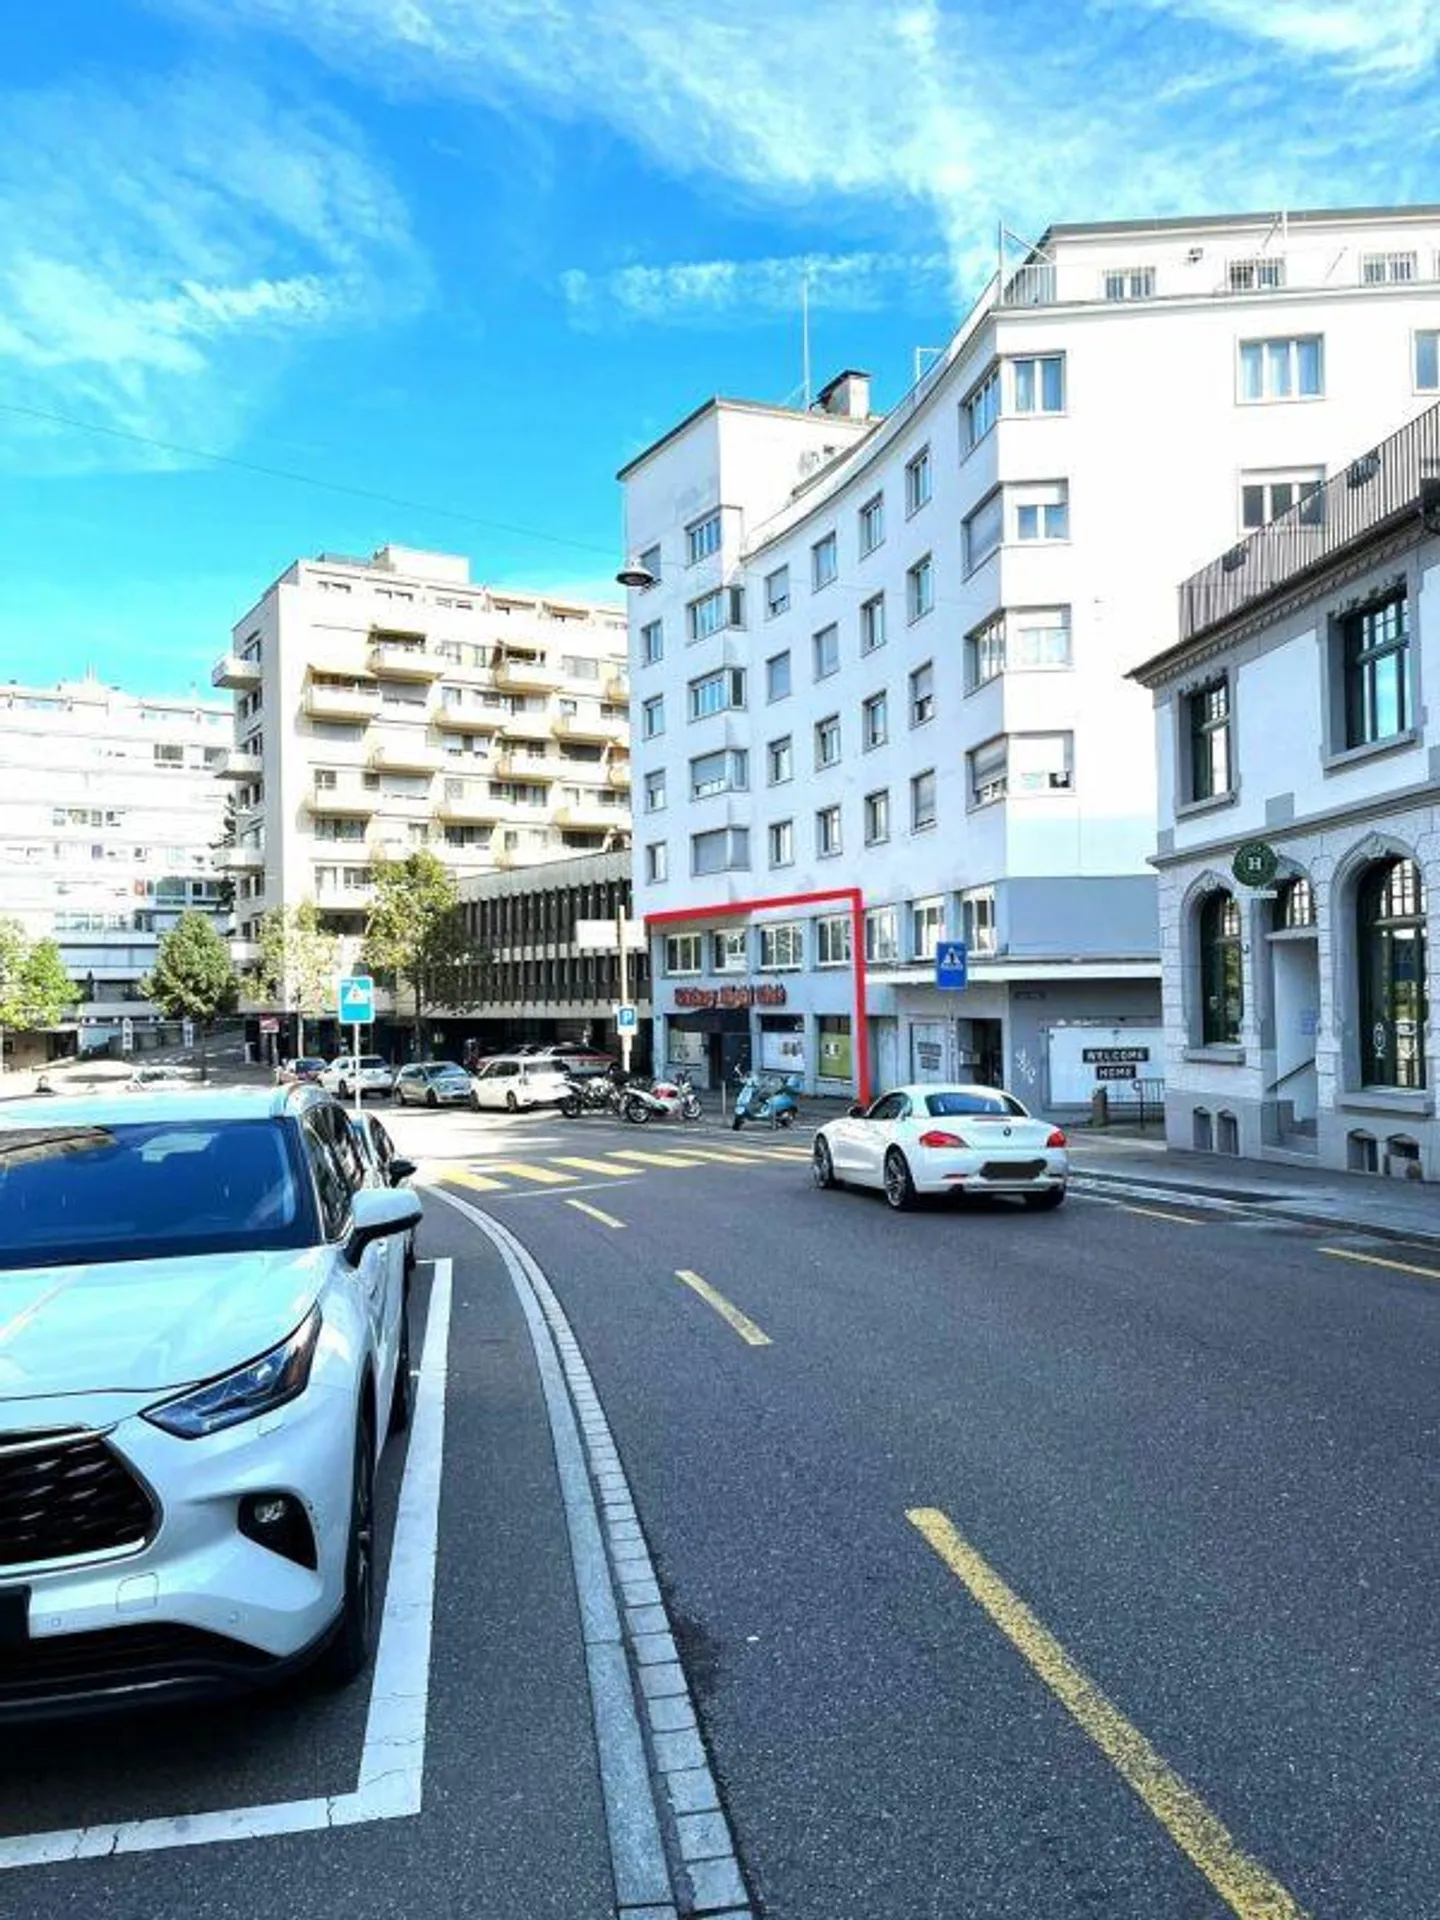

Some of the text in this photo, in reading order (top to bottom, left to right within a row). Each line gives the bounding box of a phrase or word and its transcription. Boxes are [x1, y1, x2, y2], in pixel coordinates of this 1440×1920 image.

[1248, 857, 1261, 870] H
[621, 1010, 633, 1025] P
[1086, 1050, 1145, 1061] WELCOME
[1099, 1067, 1132, 1077] HOME
